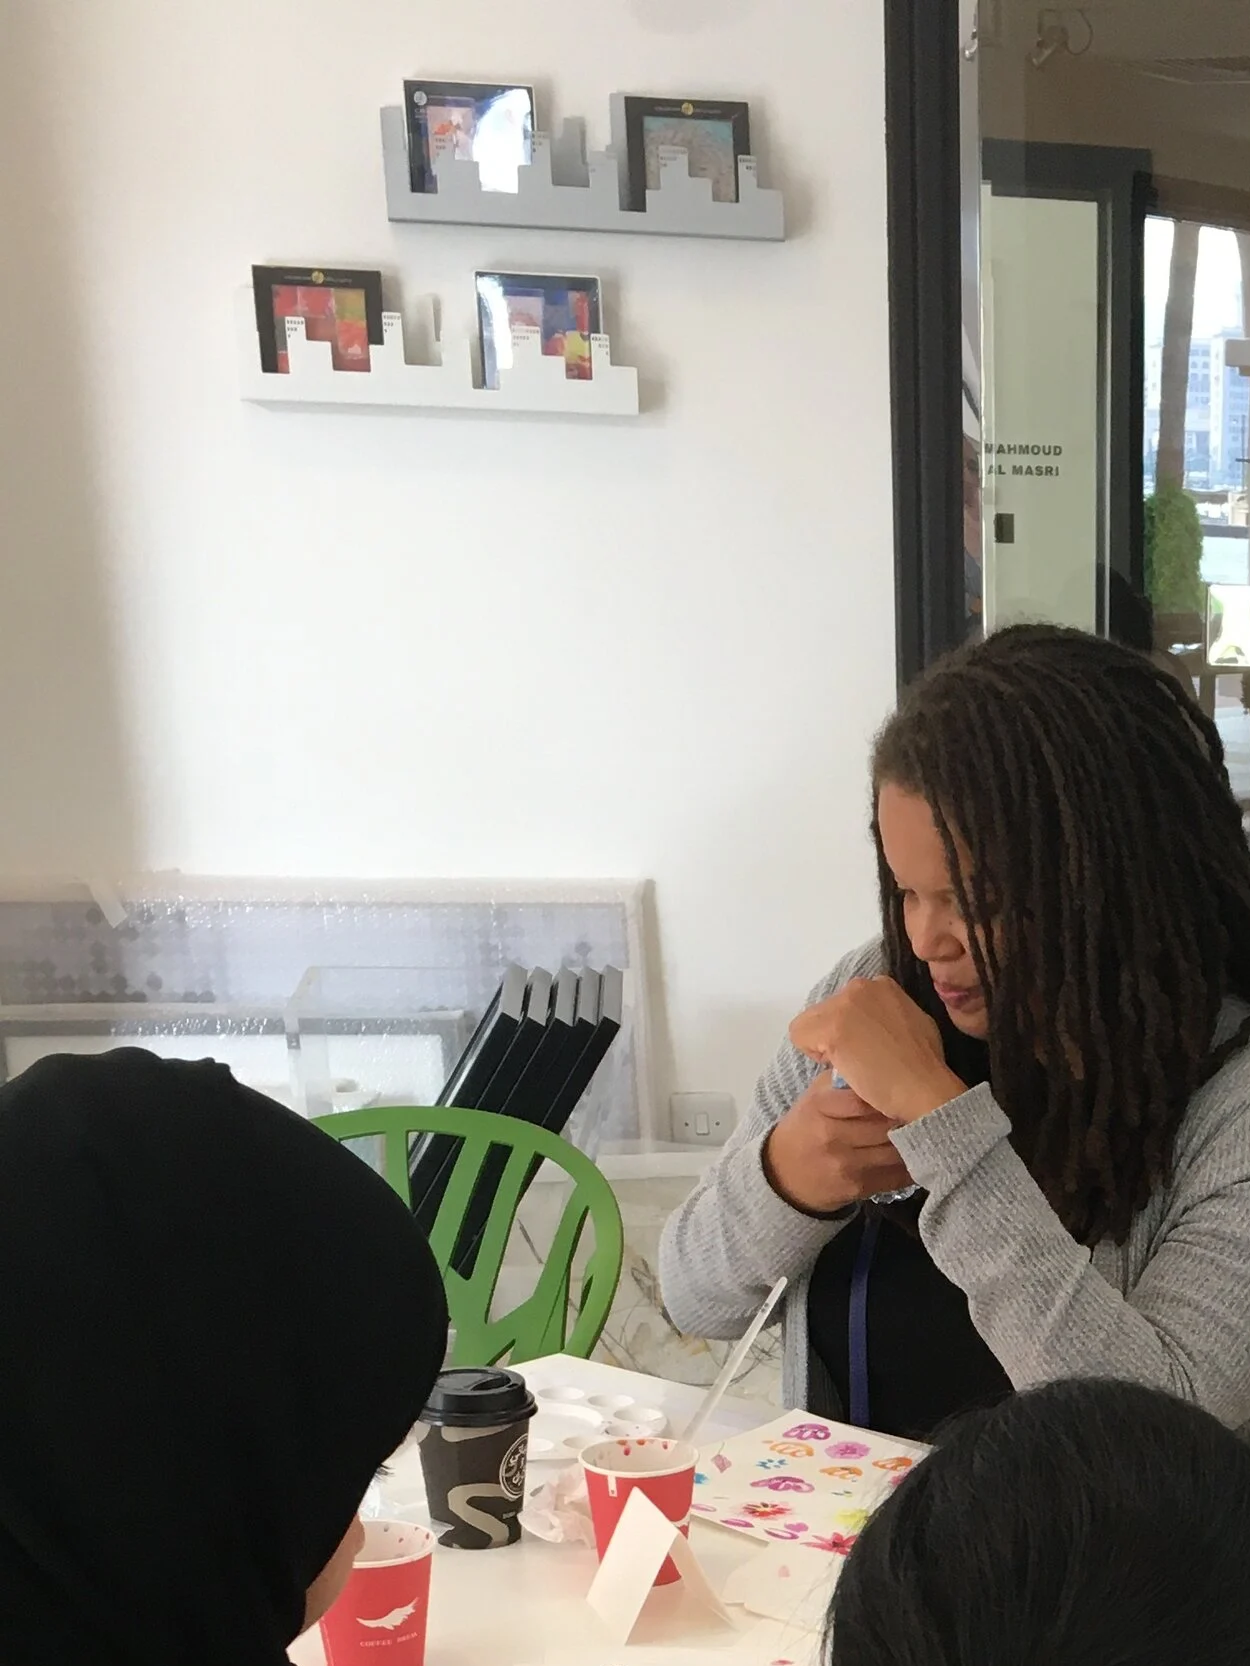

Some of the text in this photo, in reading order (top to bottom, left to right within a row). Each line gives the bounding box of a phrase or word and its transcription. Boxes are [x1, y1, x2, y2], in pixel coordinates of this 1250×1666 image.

[985, 443, 1063, 456] MAHMOUD
[987, 464, 1060, 476] AL MASRI
